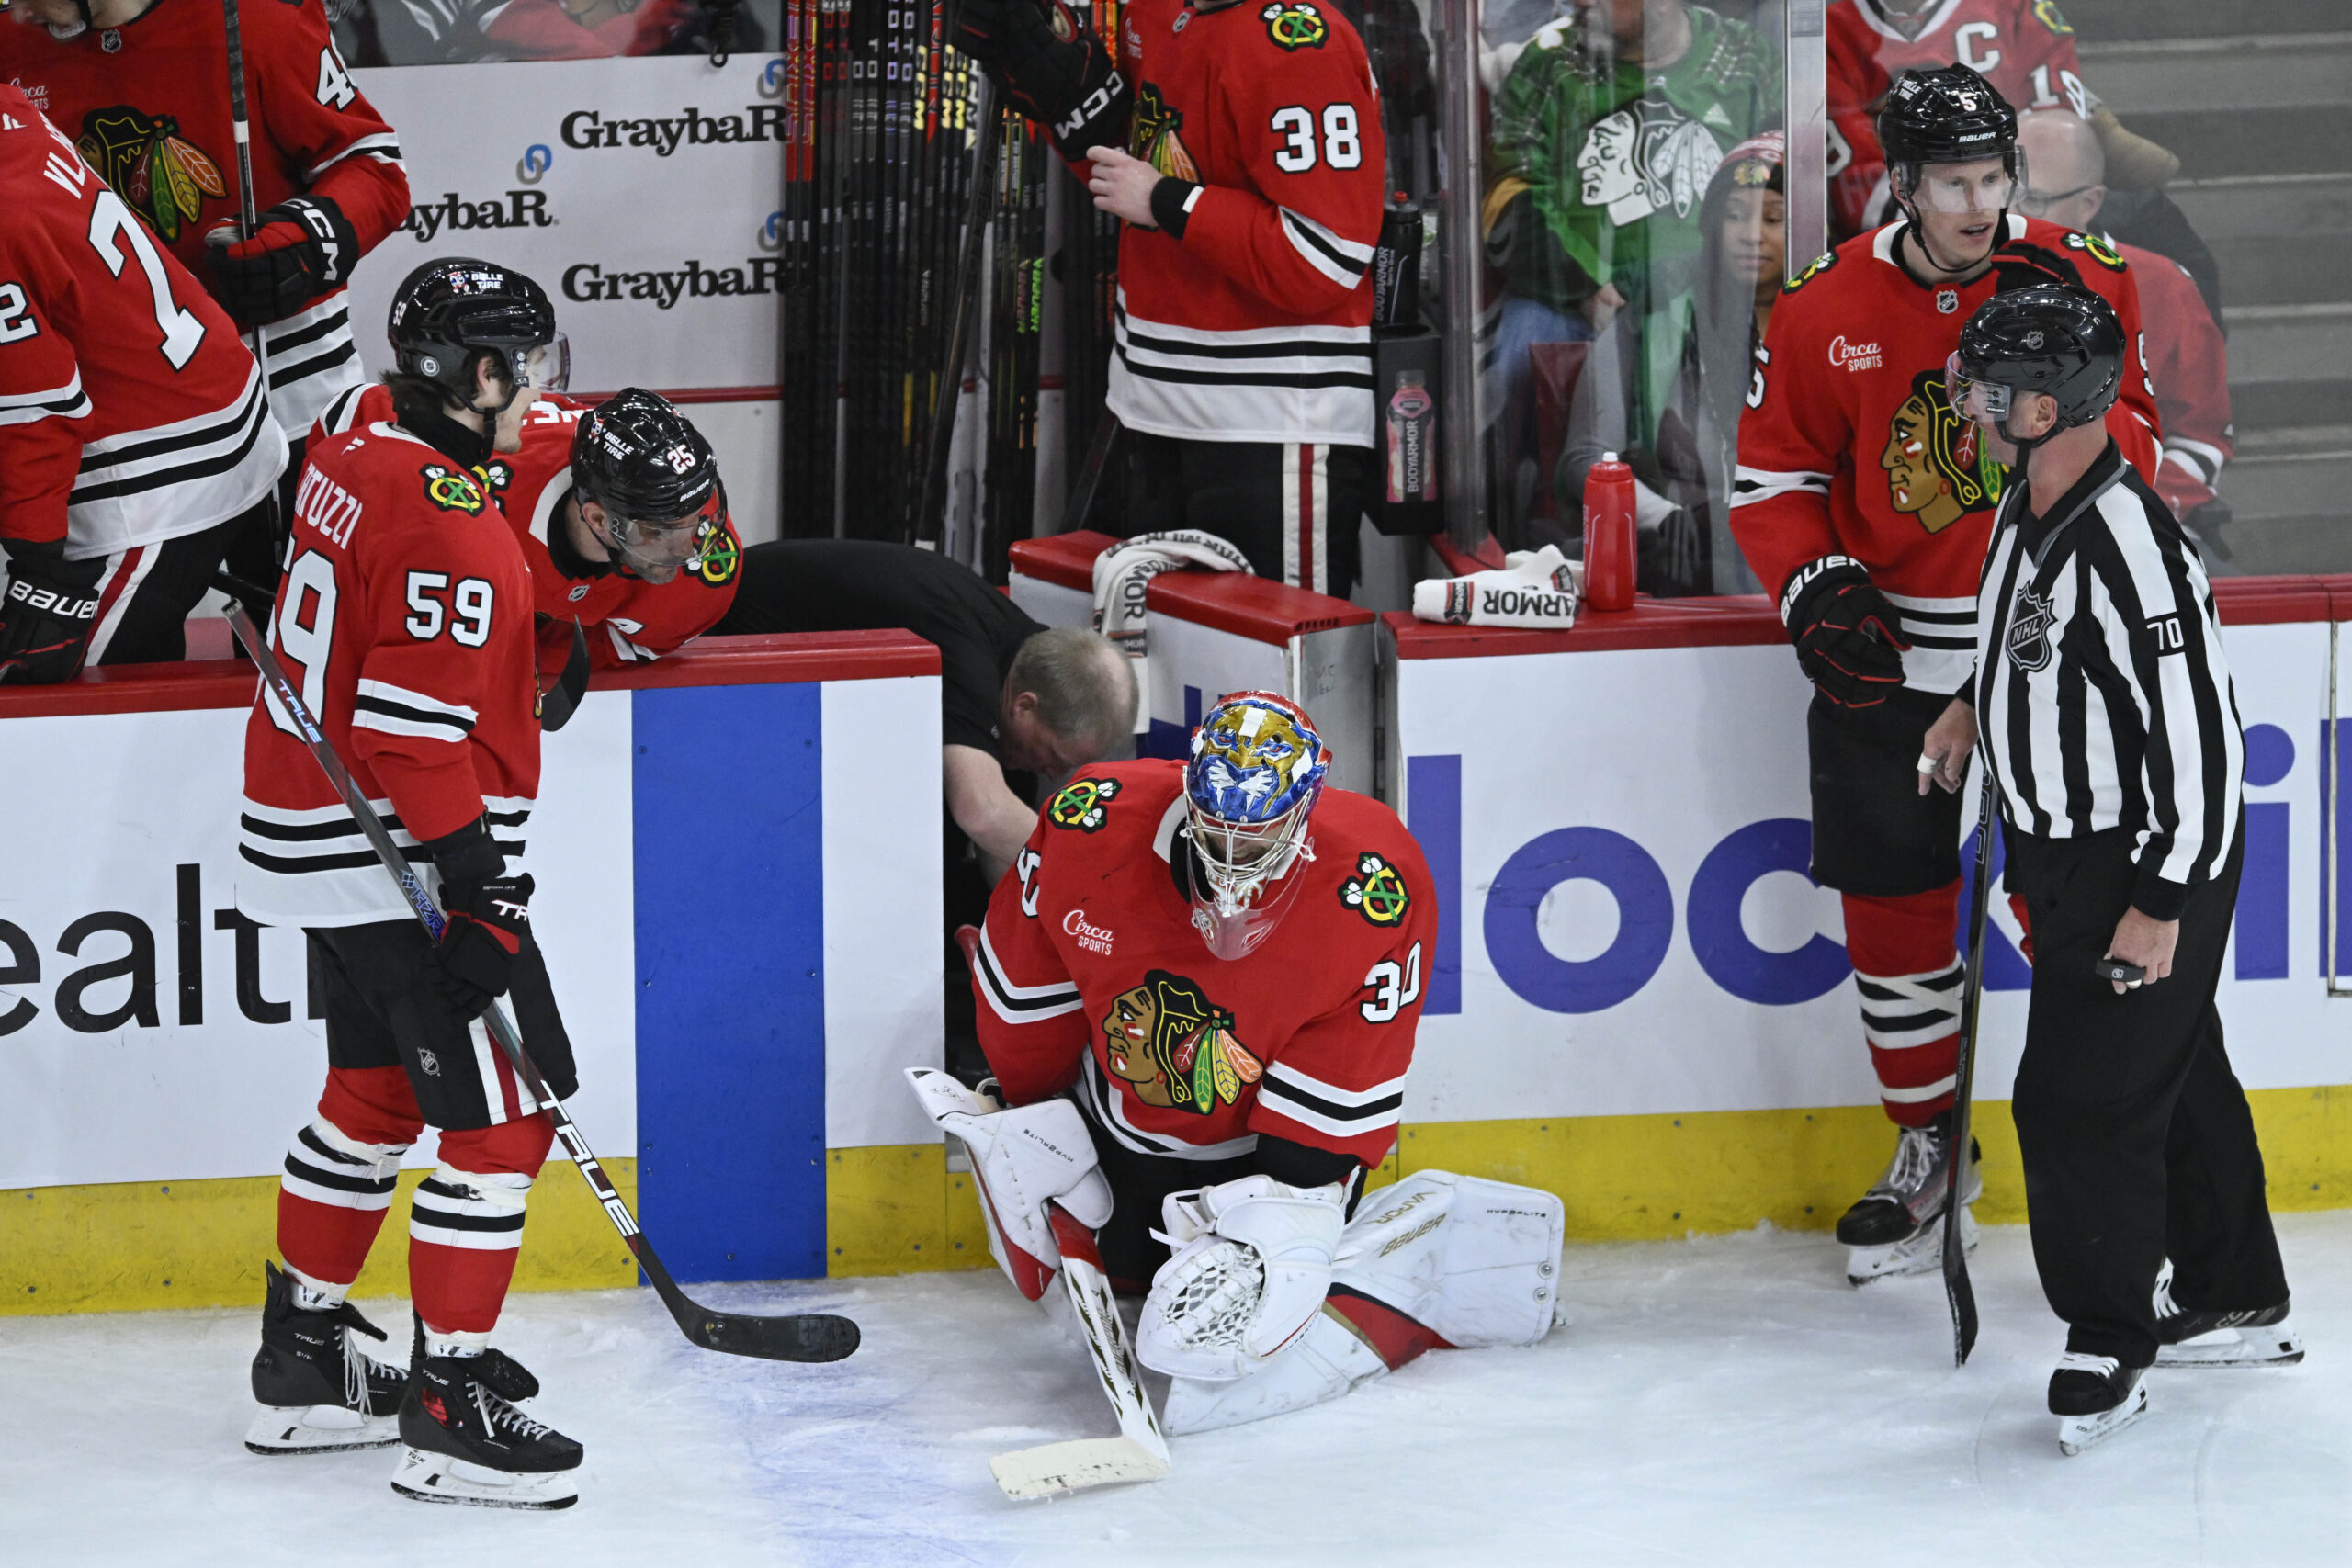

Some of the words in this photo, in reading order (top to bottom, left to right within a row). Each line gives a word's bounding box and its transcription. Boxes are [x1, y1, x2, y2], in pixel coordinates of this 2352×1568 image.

[888, 0, 899, 80] OTO
[901, 0, 915, 82] OTO
[1955, 22, 2000, 73] C
[316, 28, 358, 111] 4
[1055, 71, 1124, 140] CCM
[1958, 92, 1977, 112] 5
[560, 105, 787, 157] GraybaR
[1272, 102, 1362, 173] 38
[397, 190, 553, 242] aybaR
[278, 198, 340, 281] CCM
[471, 273, 503, 281] BELLE
[477, 281, 501, 289] TIRE
[1828, 336, 1881, 367] Circa
[1849, 355, 1883, 372] SPORTS
[603, 442, 625, 461] TIRE
[604, 431, 634, 456] BELLE
[667, 444, 696, 475] 25
[1407, 421, 1419, 493] BODYARMOR
[679, 479, 710, 502] BAUER
[405, 570, 495, 649] 59
[2011, 619, 2040, 645] NHL
[264, 531, 340, 745] 9
[2146, 617, 2185, 650] 70
[279, 678, 322, 743] TRUE
[1063, 909, 1114, 942] Circa
[1078, 935, 1112, 956] SPORTS
[1362, 939, 1422, 1023] 30
[540, 1079, 639, 1237] TRUE
[1379, 1213, 1447, 1258] BAUER
[294, 1332, 325, 1346] TRUE
[422, 1368, 450, 1386] TRUE
